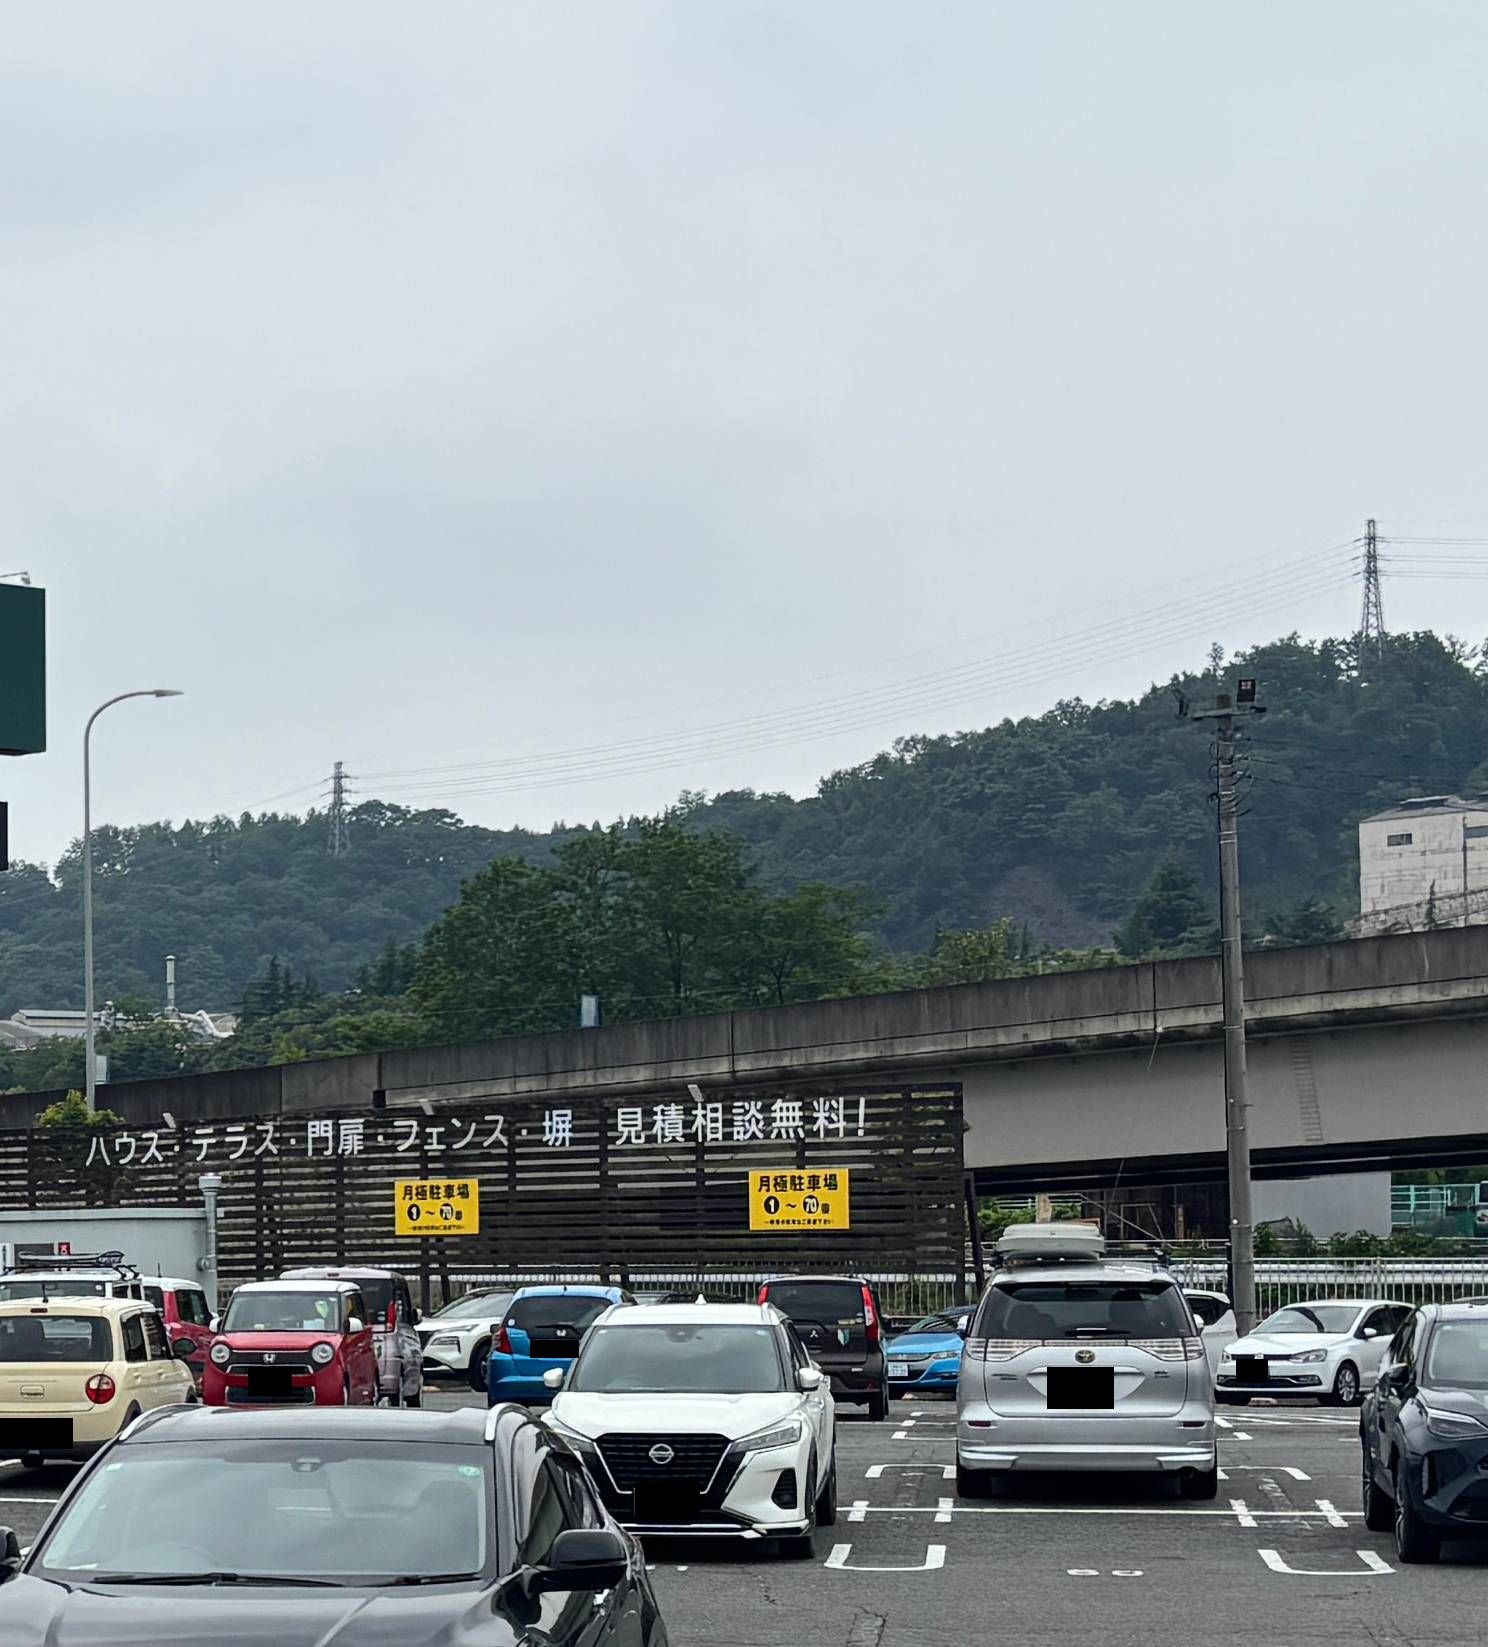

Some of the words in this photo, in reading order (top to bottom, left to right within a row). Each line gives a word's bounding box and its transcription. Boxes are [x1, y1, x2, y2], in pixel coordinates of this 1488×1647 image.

[403, 1184, 470, 1201] 月極駐車場
[758, 1174, 838, 1193] 月極駐車場
